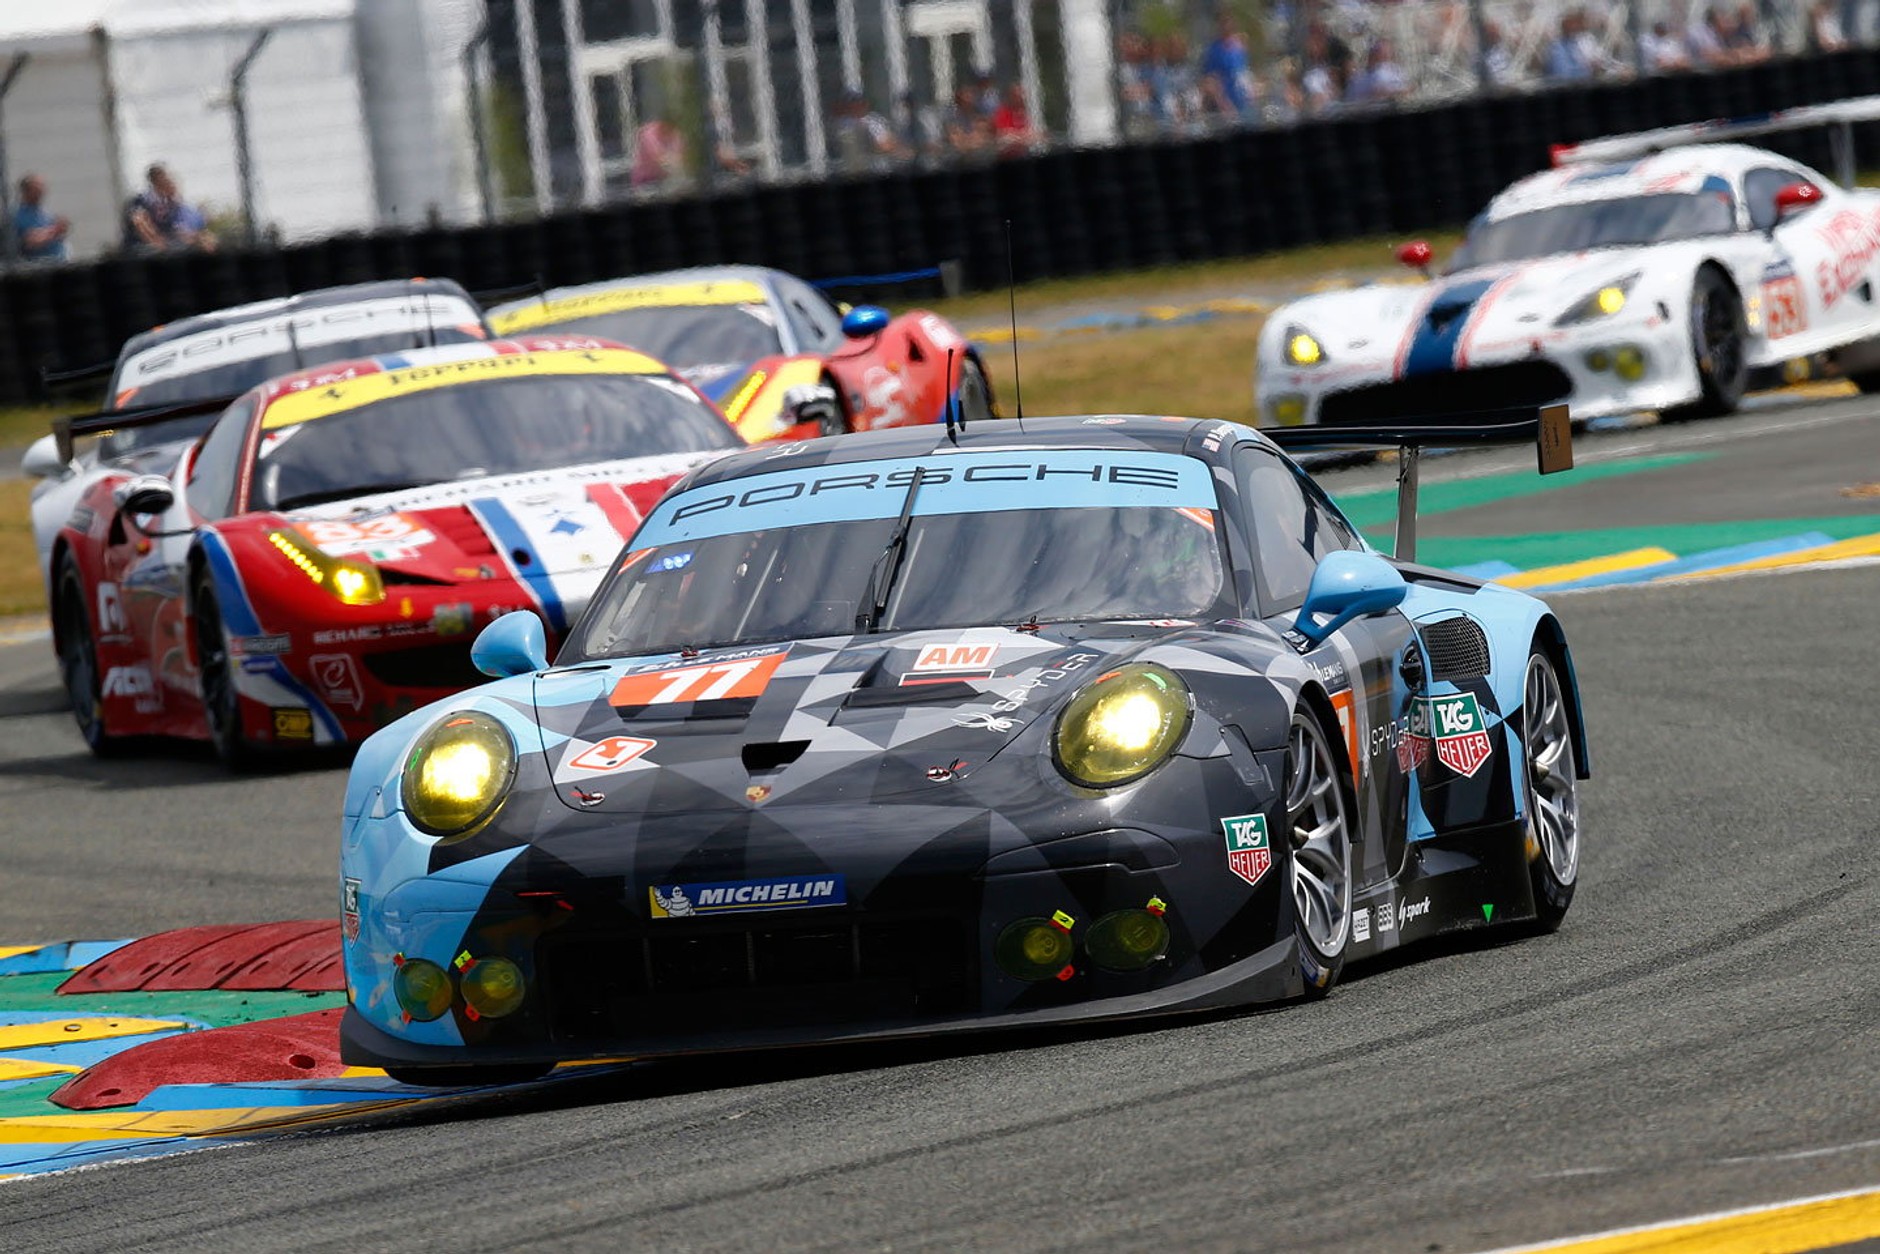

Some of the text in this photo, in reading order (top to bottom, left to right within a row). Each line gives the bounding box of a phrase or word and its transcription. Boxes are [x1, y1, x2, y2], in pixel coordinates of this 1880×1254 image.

[669, 463, 1180, 526] PORSCHE
[919, 646, 992, 666] AM
[647, 659, 763, 705] 77
[991, 652, 1099, 712] SPYDER
[1436, 700, 1474, 734] TAG
[1439, 735, 1488, 771] HEUER
[1230, 819, 1262, 848] TAG
[1231, 850, 1269, 880] HEUER
[698, 880, 835, 906] MICHELIN
